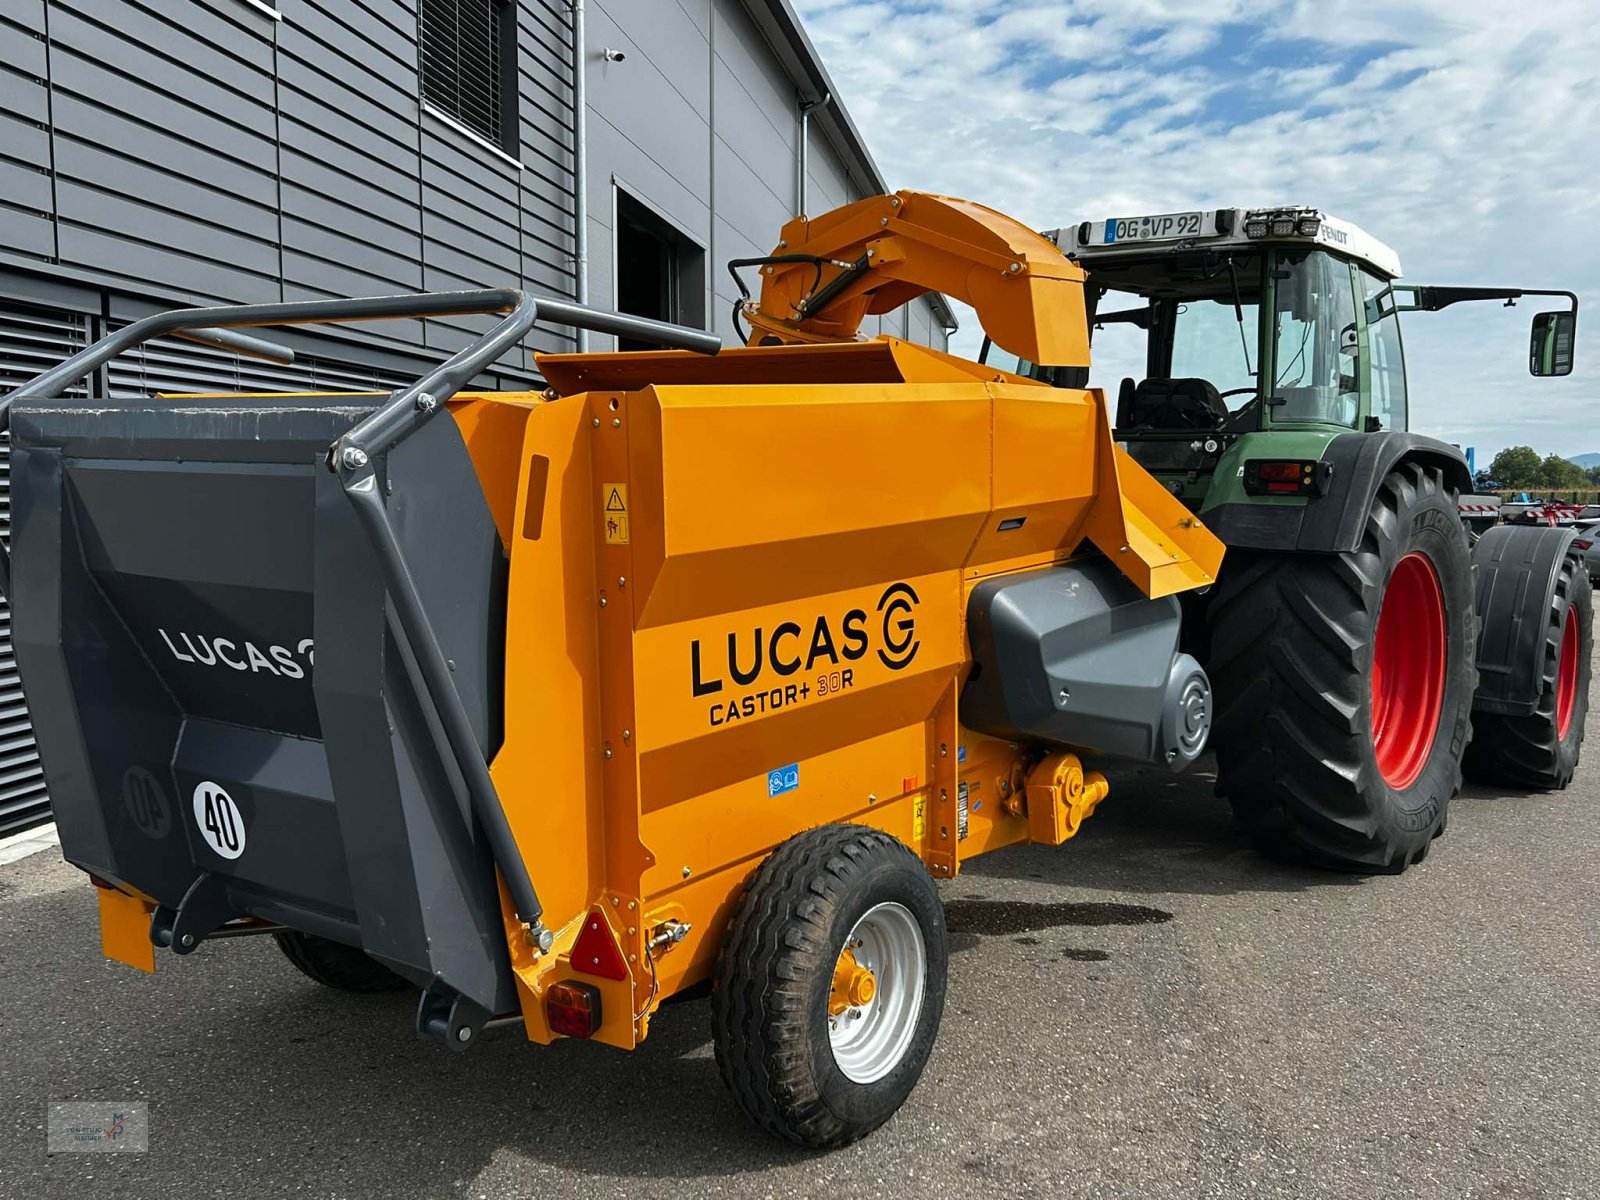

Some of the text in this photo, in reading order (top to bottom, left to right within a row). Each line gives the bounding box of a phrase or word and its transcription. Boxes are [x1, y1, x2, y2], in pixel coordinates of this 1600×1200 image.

[1116, 215, 1200, 239] OG VP 92
[1320, 223, 1348, 245] FENDT
[157, 628, 305, 679] LUCAS
[691, 609, 869, 698] LUCAS
[710, 668, 854, 727] CASTOR+ 30R
[204, 791, 240, 852] 40
